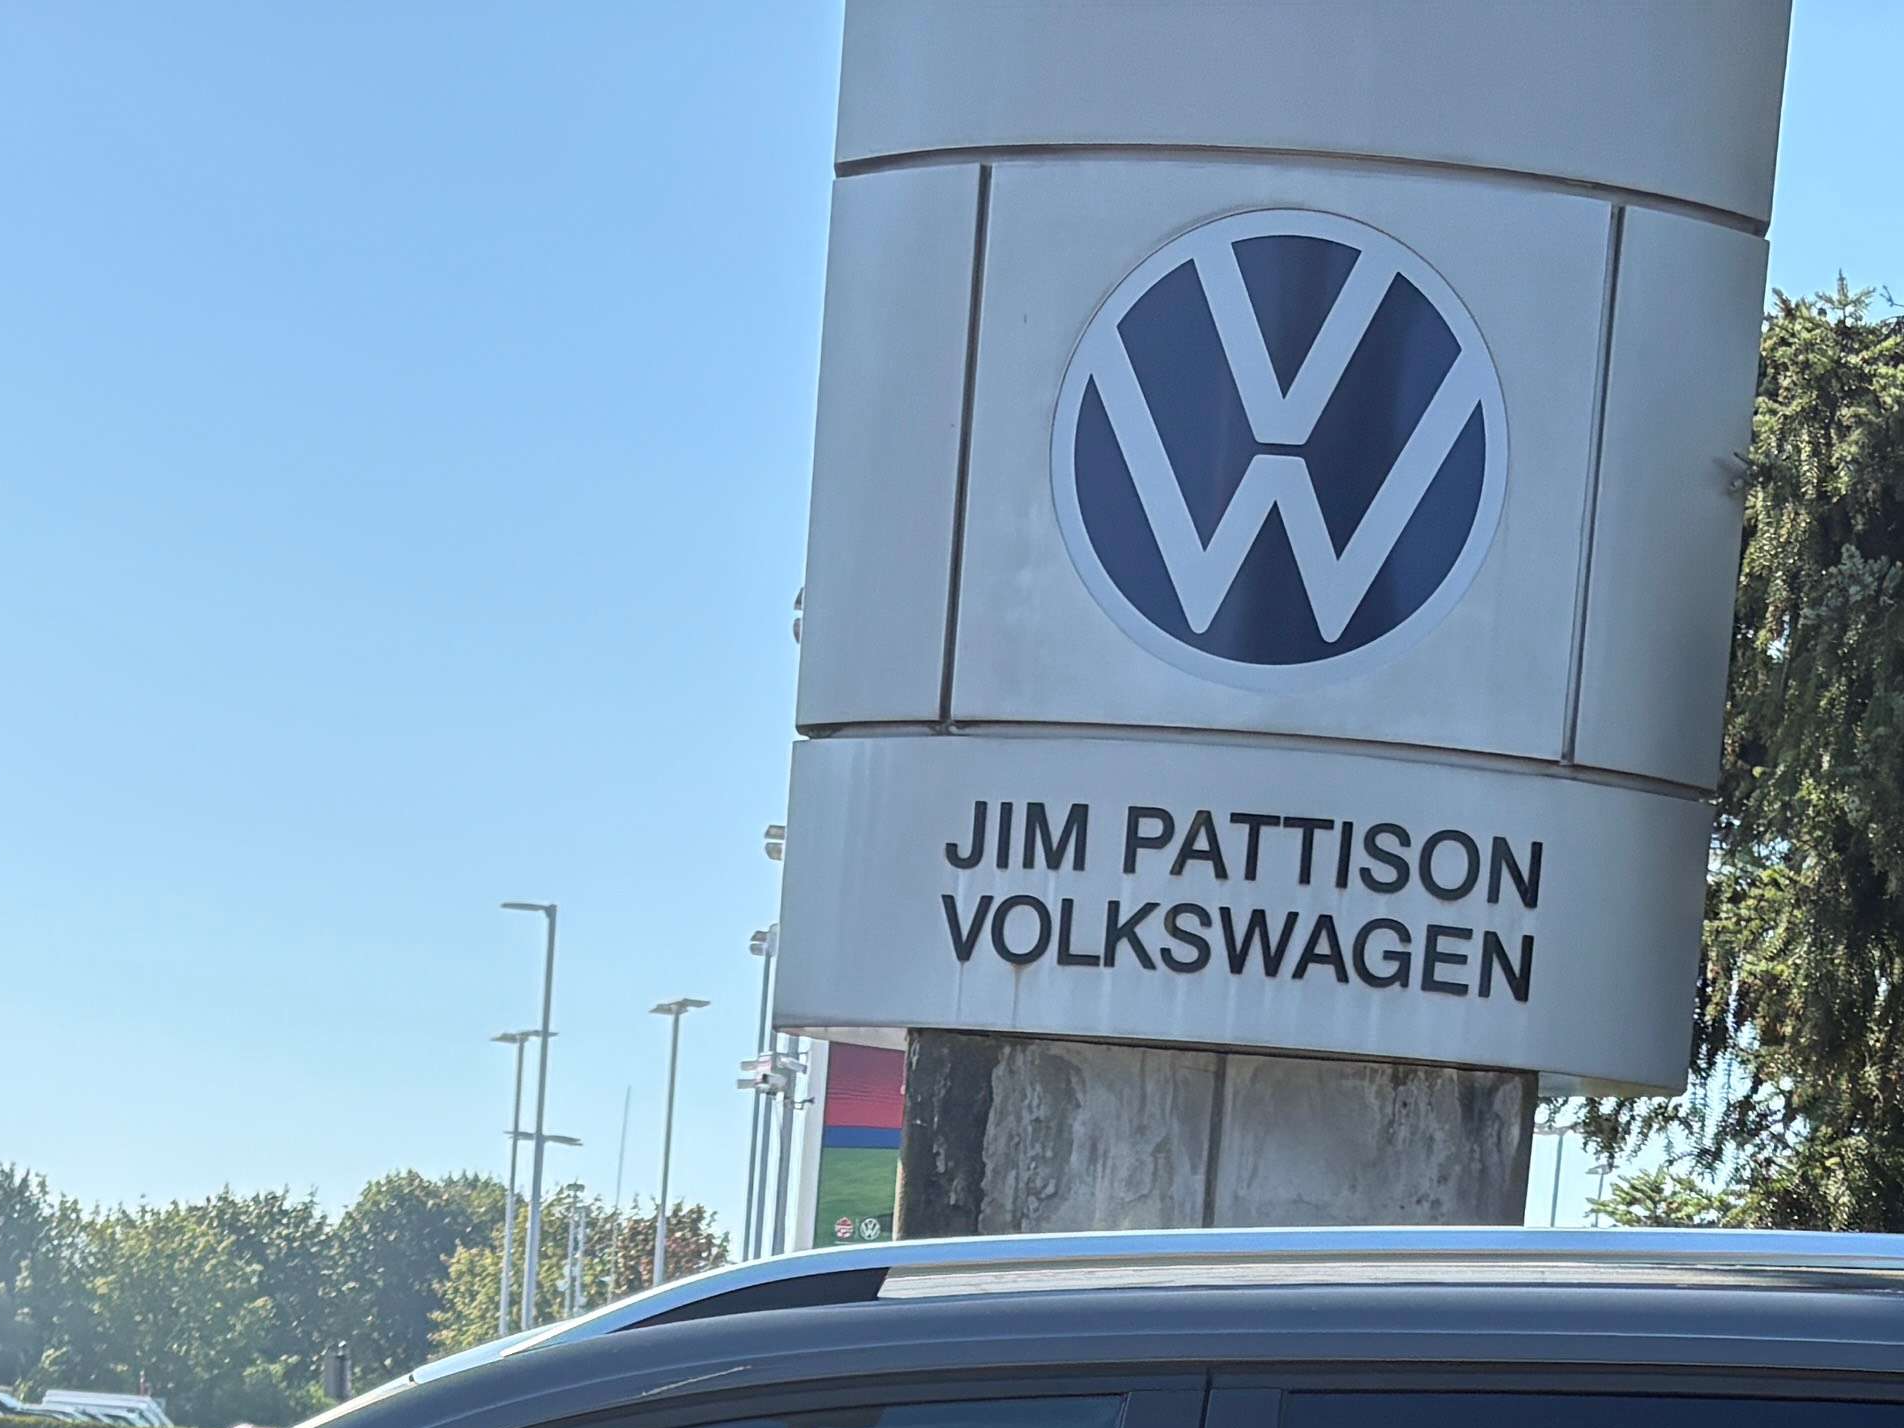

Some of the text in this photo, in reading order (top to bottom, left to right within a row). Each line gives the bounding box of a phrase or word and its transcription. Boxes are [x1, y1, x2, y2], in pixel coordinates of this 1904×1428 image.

[1051, 208, 1509, 690] VW
[945, 800, 1543, 909] JIM PATTISON
[941, 894, 1534, 1003] VOLKSWAGEN
